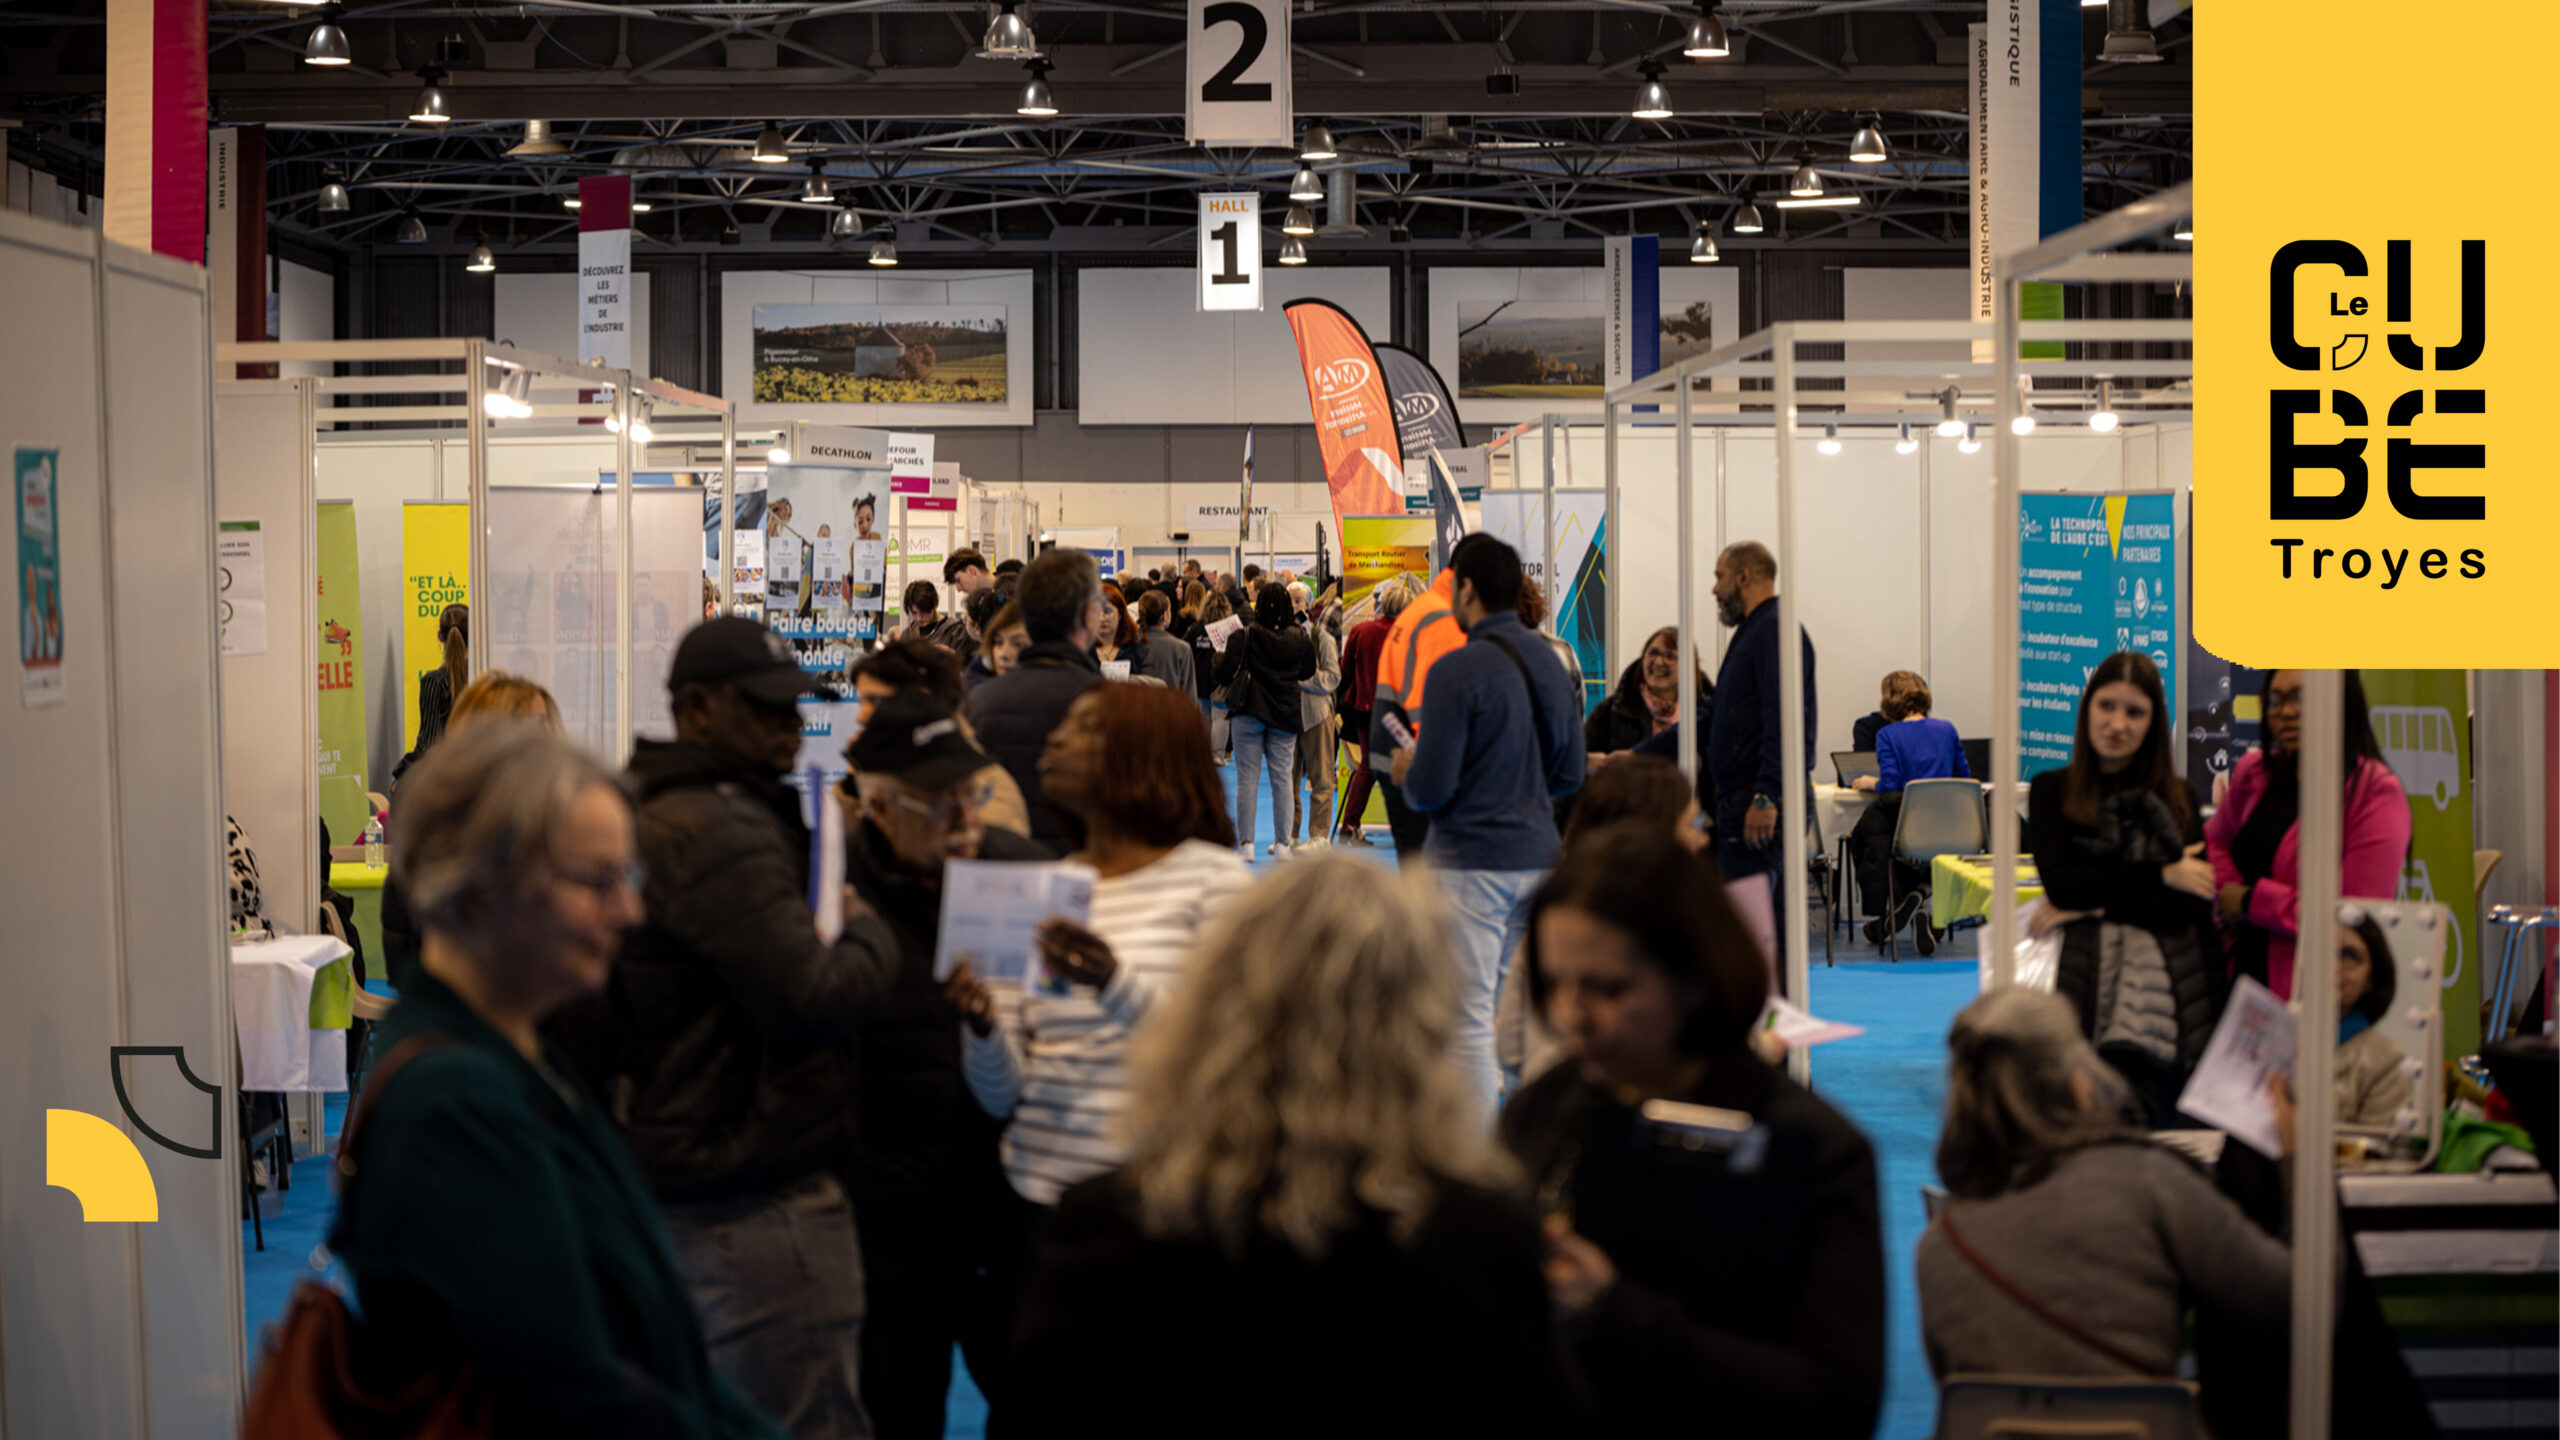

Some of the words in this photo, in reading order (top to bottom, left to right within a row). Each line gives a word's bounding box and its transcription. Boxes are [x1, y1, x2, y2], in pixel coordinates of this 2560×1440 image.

[1202, 2, 1272, 102] 2
[1980, 179, 1988, 190] &
[1209, 200, 1250, 213] HALL
[1211, 221, 1250, 285] 1
[582, 265, 625, 277] DÉCOUVREZ
[597, 280, 610, 291] LES
[588, 294, 619, 305] MÉTIERS
[598, 309, 608, 319] DE
[584, 322, 625, 334] L'INDUSTRIE
[811, 445, 872, 460] DECATHLON
[887, 446, 916, 455] EFOUR
[891, 457, 924, 467] ARCHÉS
[1199, 506, 1269, 516] RESTAUANT
[2051, 517, 2060, 530] LA
[2051, 531, 2060, 545] DE
[418, 590, 465, 603] COUP
[418, 605, 440, 617] DU
[770, 611, 812, 632] Faire
[816, 612, 874, 637] bouger
